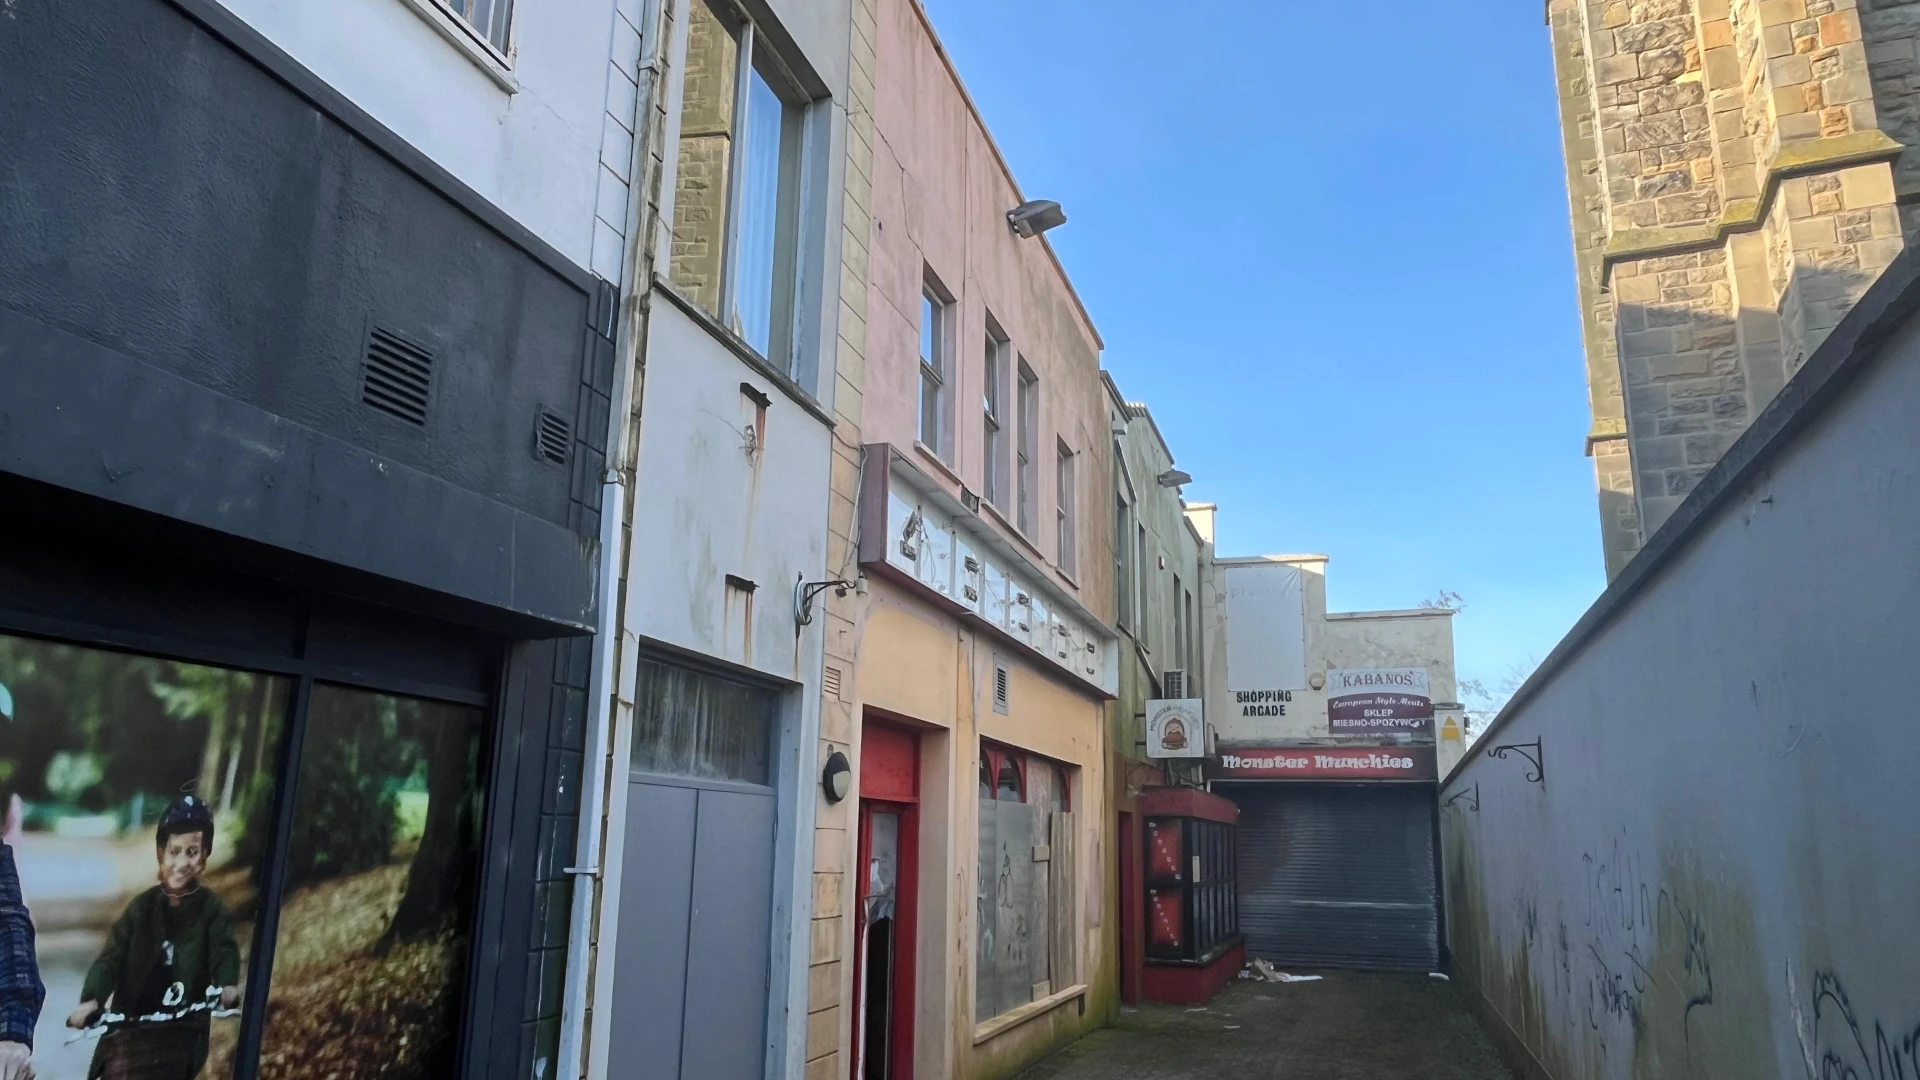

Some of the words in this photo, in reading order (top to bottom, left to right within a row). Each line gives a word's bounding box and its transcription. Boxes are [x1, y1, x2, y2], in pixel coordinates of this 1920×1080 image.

[1342, 673, 1414, 688] KABANOS
[1236, 690, 1293, 703] SHOPPING
[1375, 696, 1397, 706] Style
[1242, 704, 1286, 717] ARCADE
[1363, 708, 1394, 717] SKLEP
[1221, 755, 1309, 769] Monster
[1313, 753, 1414, 769] Munchies
